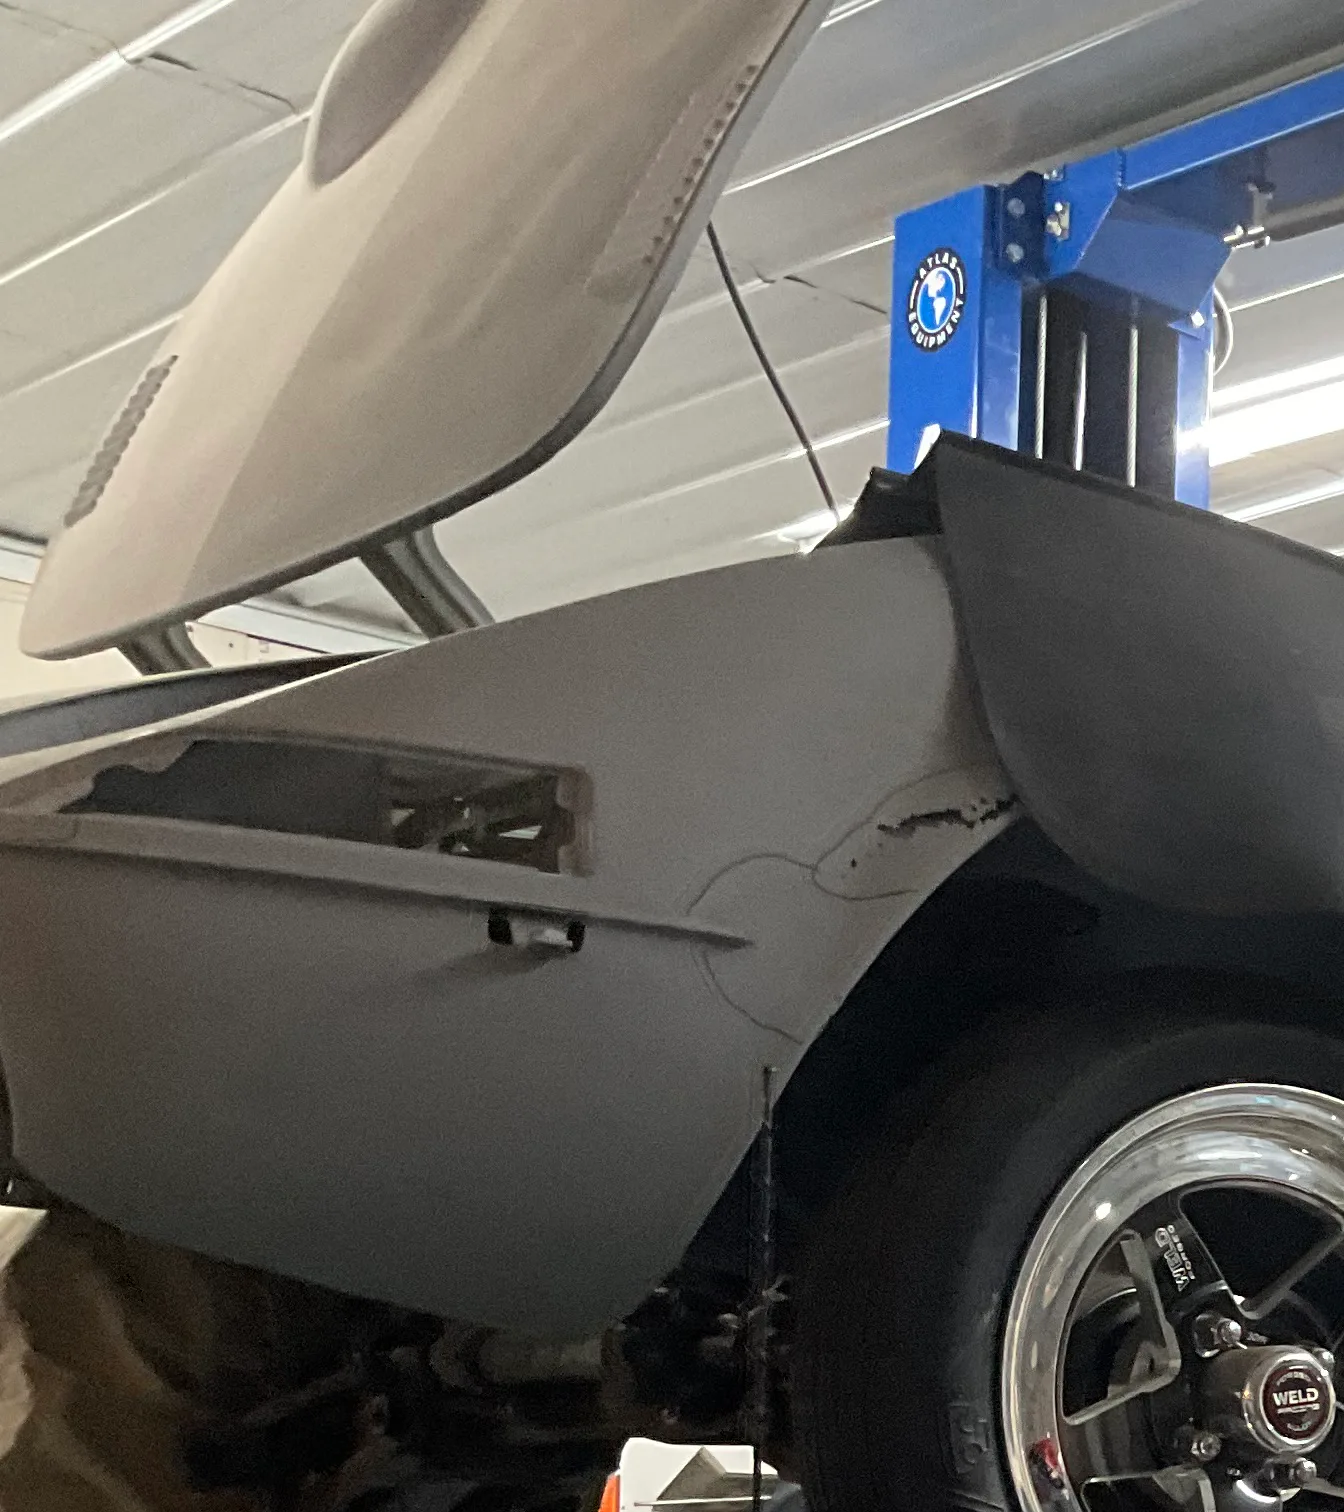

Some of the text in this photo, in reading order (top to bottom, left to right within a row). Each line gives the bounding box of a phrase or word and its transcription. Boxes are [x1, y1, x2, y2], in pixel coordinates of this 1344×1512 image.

[919, 252, 958, 280] ATLAS
[908, 297, 964, 349] EQUIPMENT
[1155, 1227, 1190, 1292] WELD
[1272, 1387, 1319, 1407] WELD
